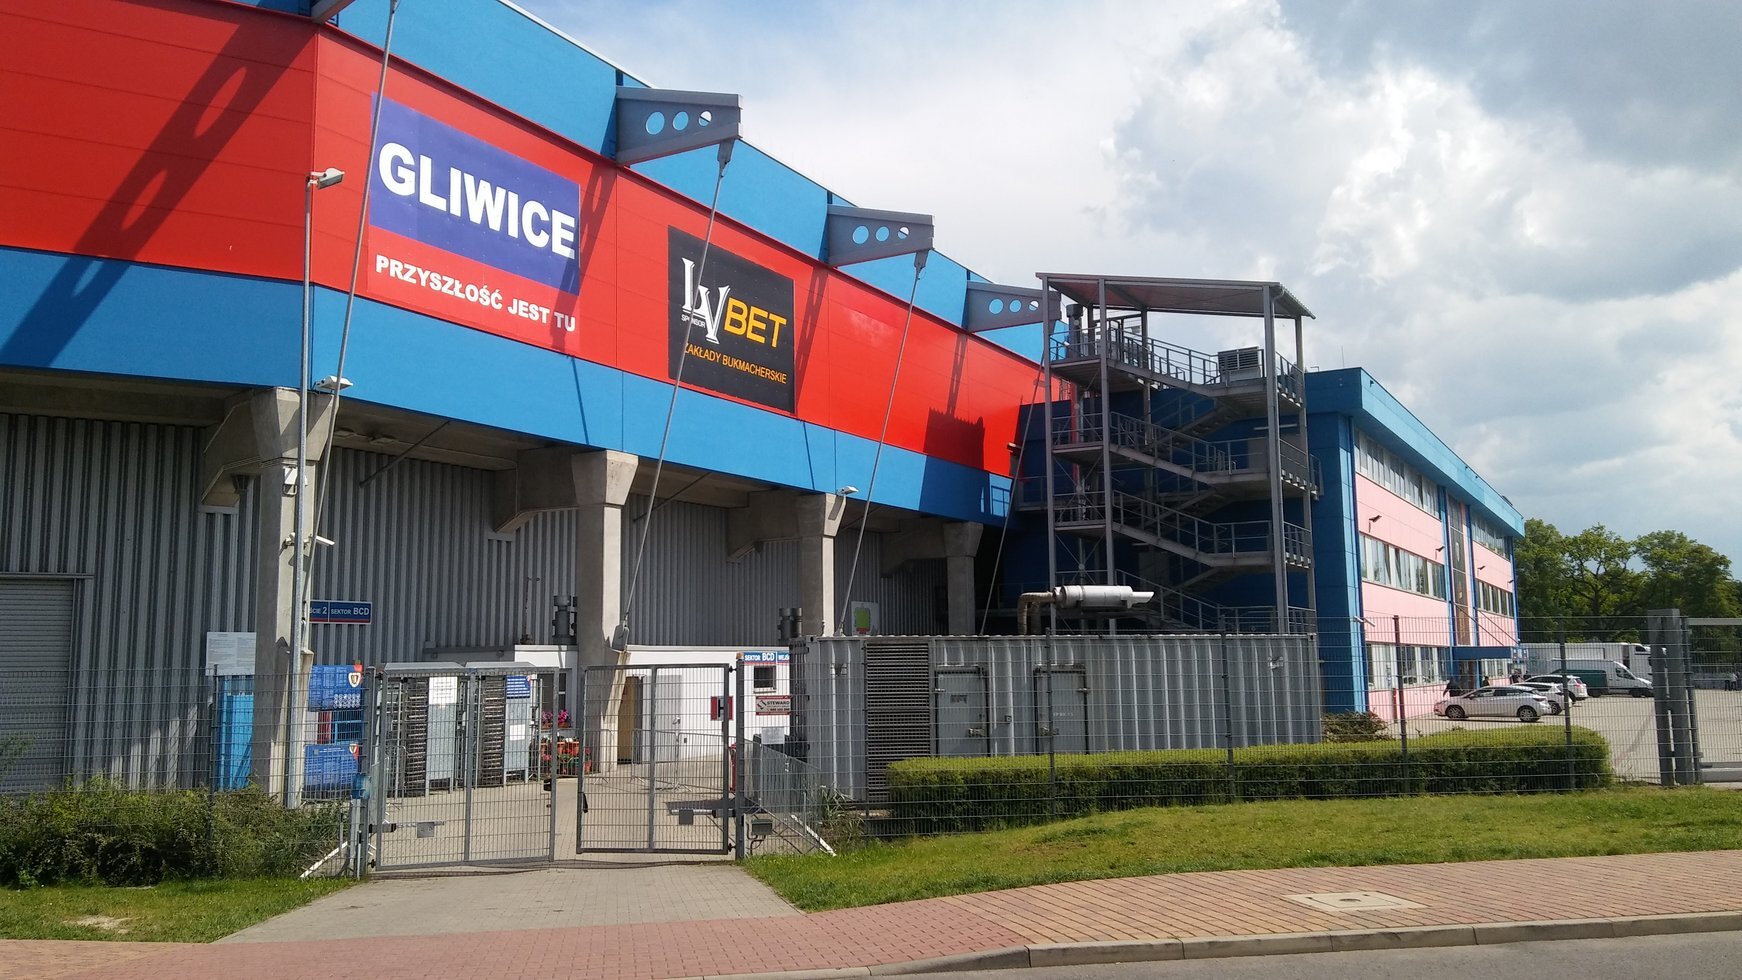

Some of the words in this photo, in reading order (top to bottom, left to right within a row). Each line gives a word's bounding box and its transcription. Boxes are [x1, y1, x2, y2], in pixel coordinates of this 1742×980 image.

[379, 142, 575, 260] GLIWICE
[376, 254, 502, 310] PRZYSZŁOŚĆ
[507, 298, 550, 324] JEST
[554, 311, 576, 332] TU
[681, 314, 706, 328] SPNSOR
[722, 354, 787, 384] BUKMACHERSKIE
[322, 606, 328, 615] 2
[353, 607, 370, 615] BCD
[762, 652, 775, 661] BCD
